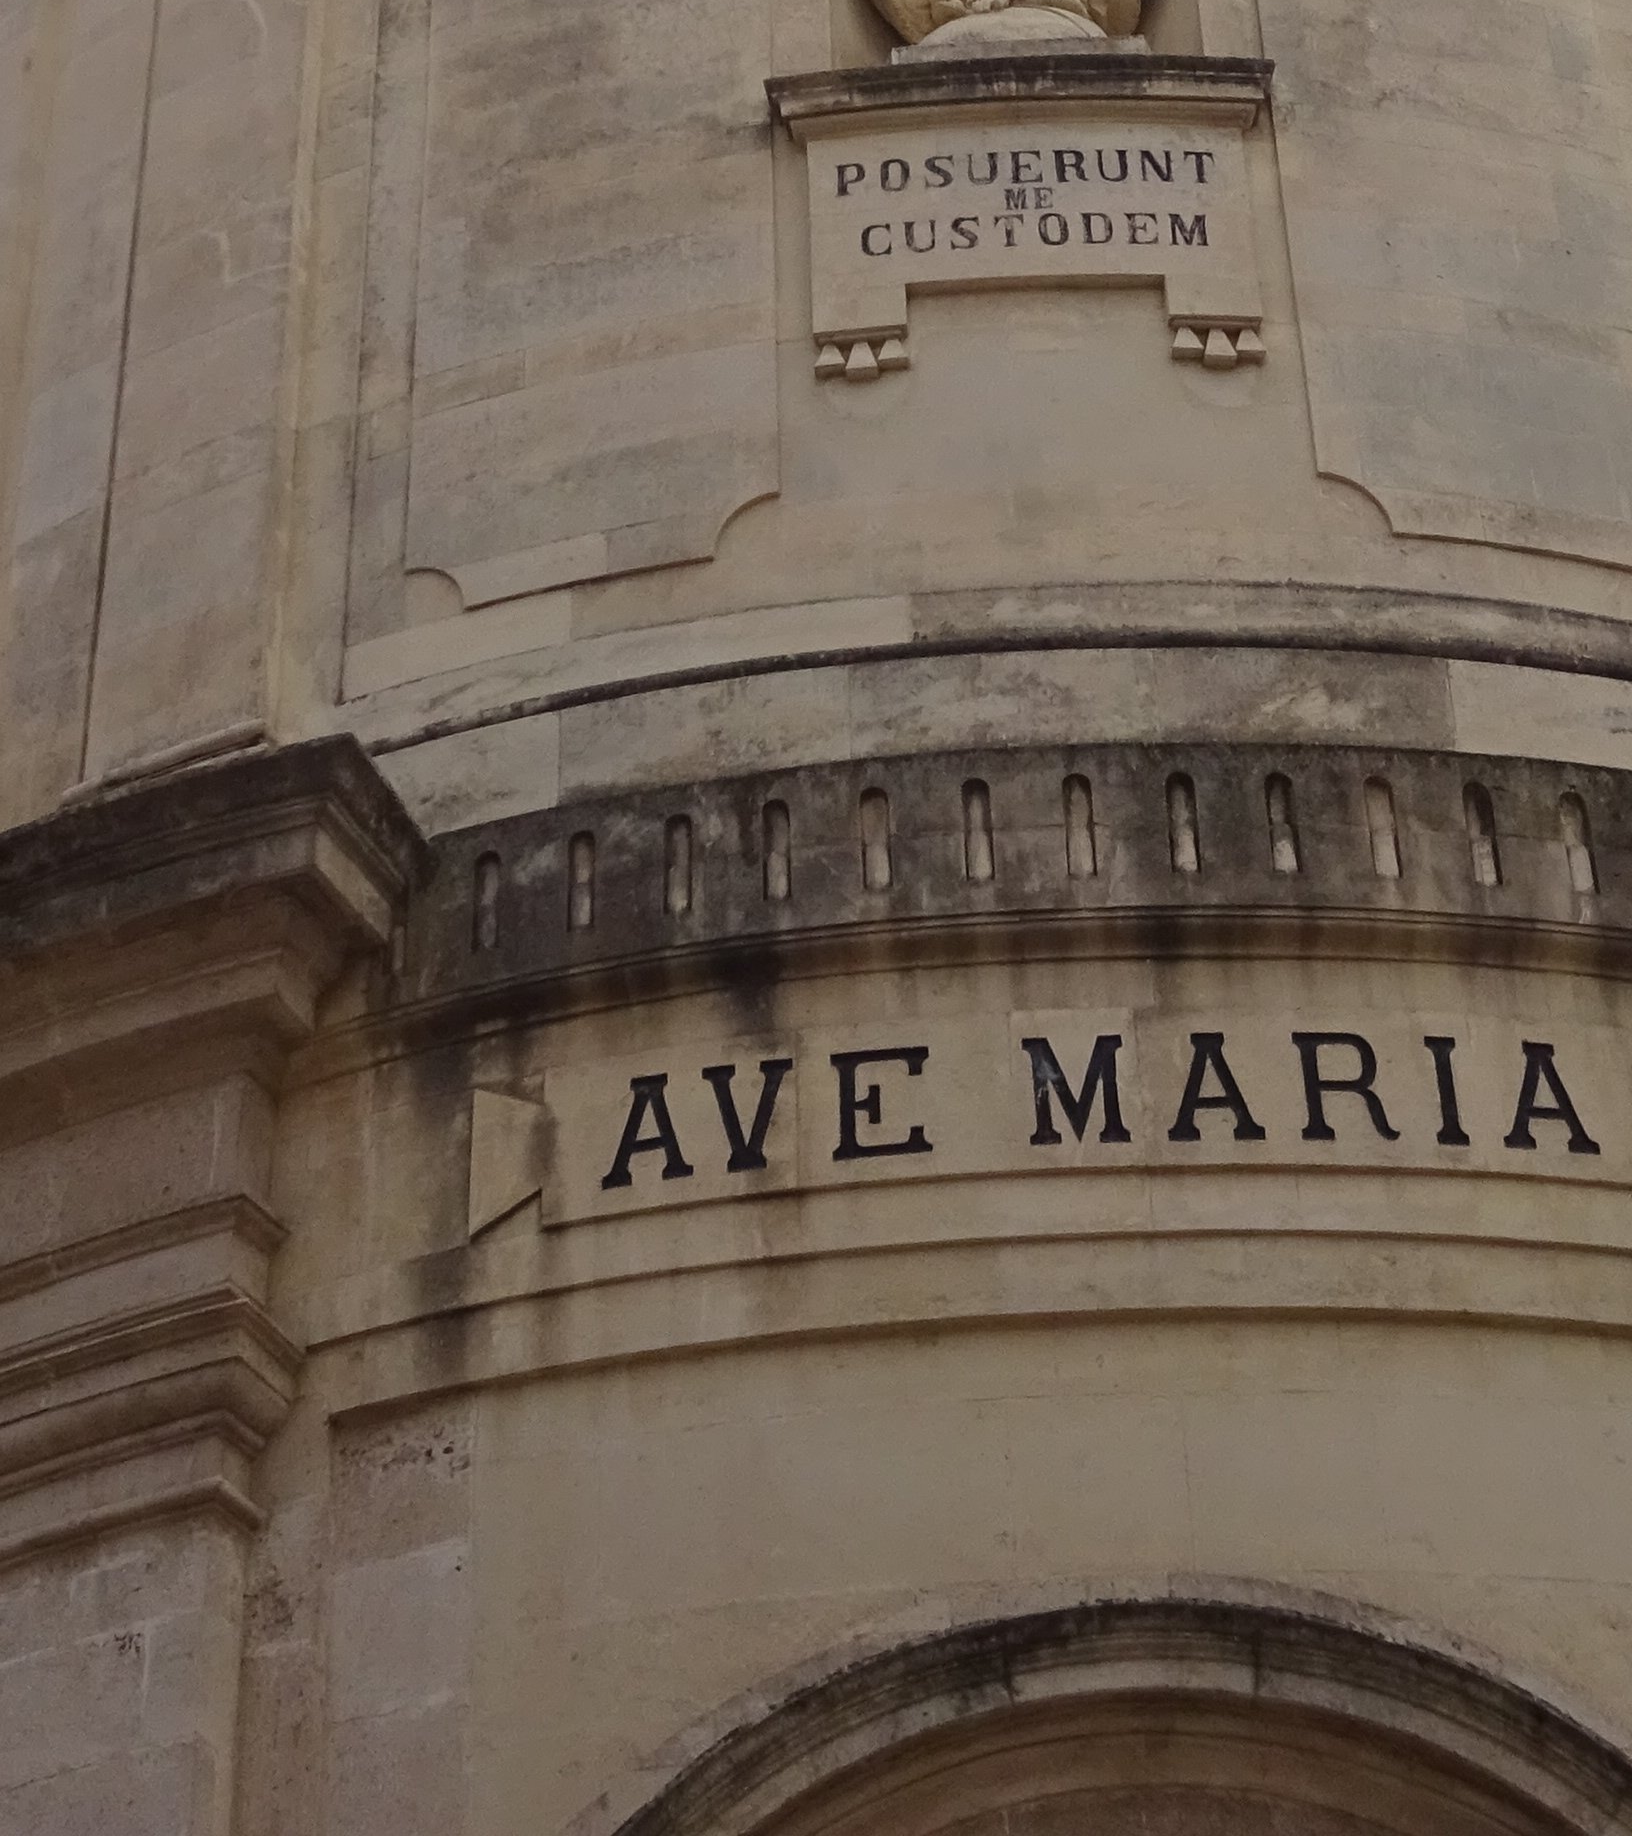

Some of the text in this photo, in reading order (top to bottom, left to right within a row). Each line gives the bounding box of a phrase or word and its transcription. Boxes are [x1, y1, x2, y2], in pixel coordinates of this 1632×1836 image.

[835, 148, 1215, 197] POSUERUNT
[1004, 186, 1055, 211] ME
[860, 211, 1210, 257] CUSTODEM
[601, 1031, 1603, 1191] AVE MARIA
